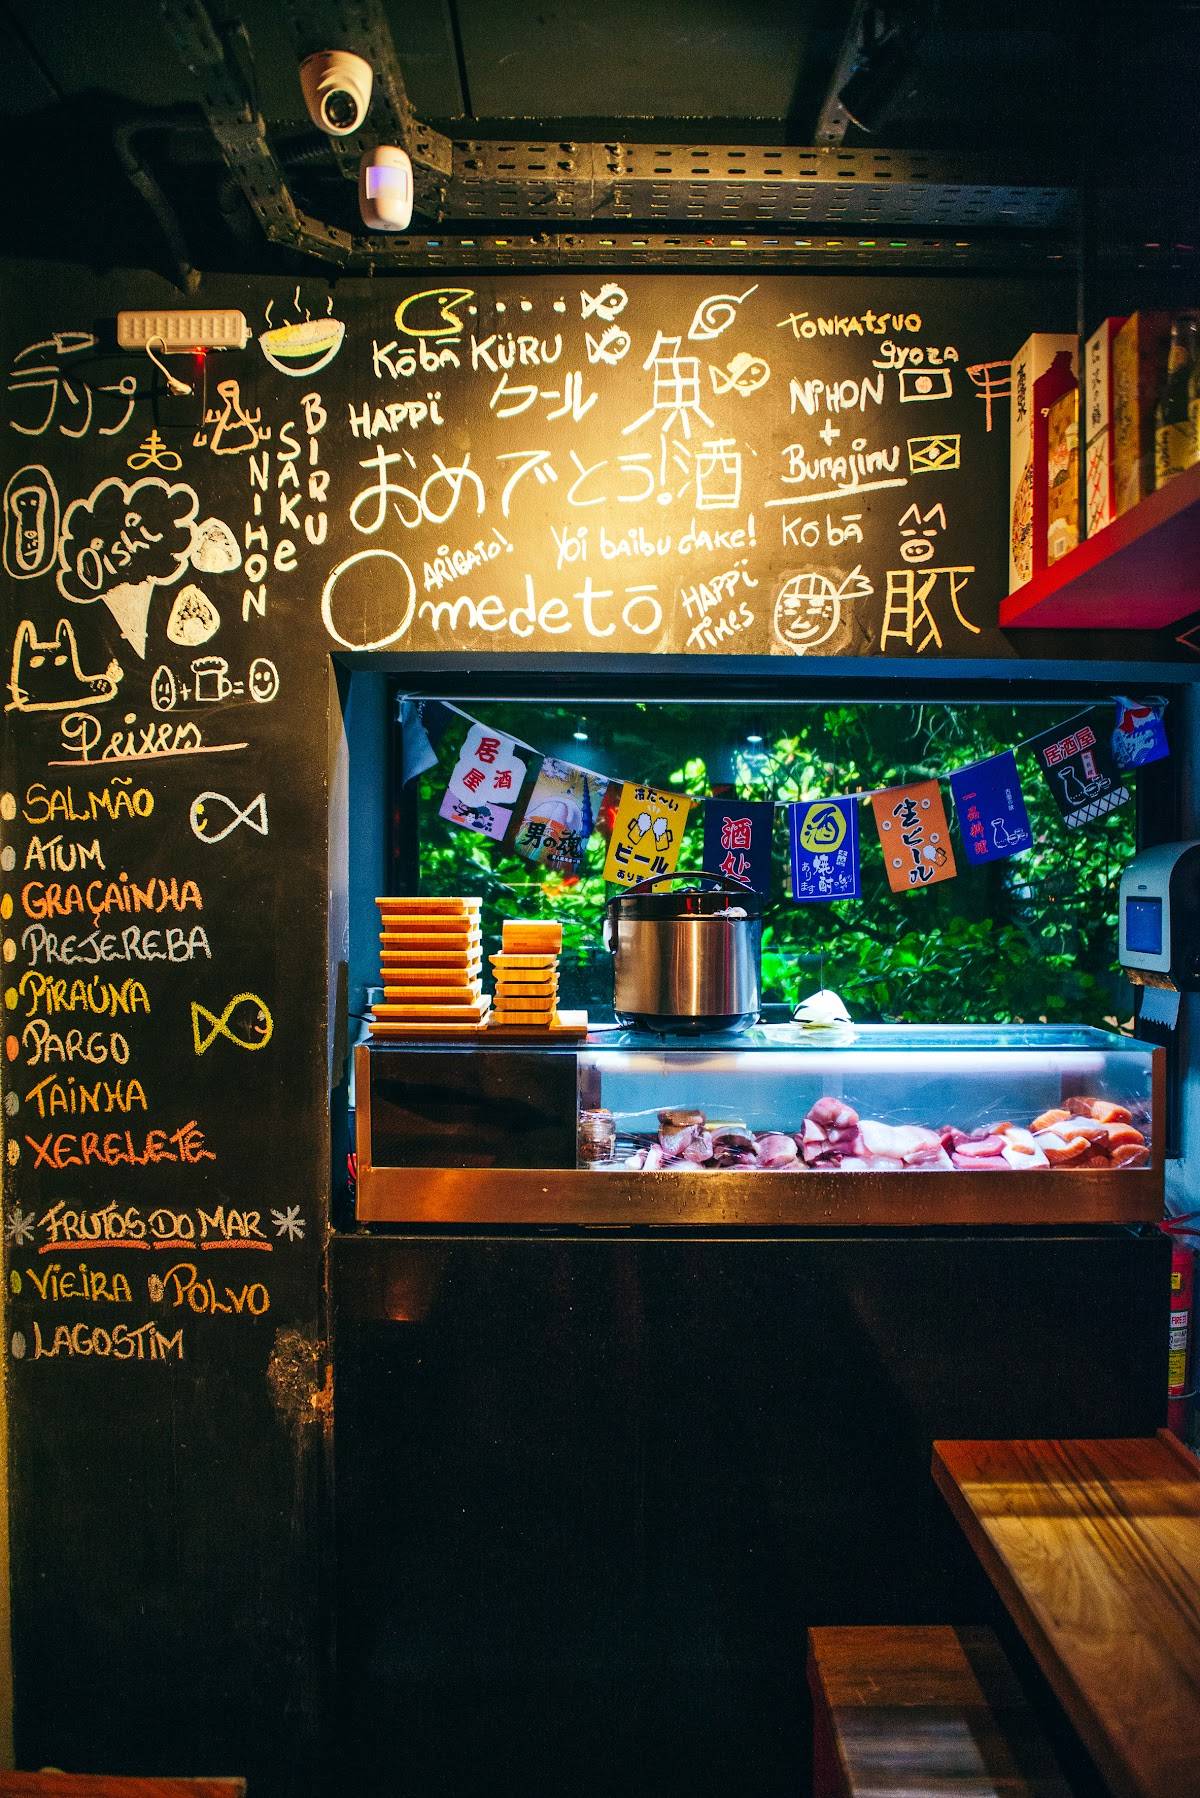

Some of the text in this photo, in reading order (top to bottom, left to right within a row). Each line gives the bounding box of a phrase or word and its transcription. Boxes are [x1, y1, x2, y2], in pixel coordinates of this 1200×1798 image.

[489, 371, 598, 421] クール
[621, 330, 715, 439] 魚
[1042, 725, 1097, 768] 居酒屋
[22, 777, 155, 824] SALMÃO
[24, 835, 106, 872] ATUM
[615, 842, 669, 875] ビール
[21, 922, 212, 966] PREJEREBA
[23, 1019, 129, 1066] PARGO
[25, 1120, 216, 1169] XERELETE
[149, 1209, 195, 1240] DO
[197, 1205, 267, 1240] MAR
[163, 1262, 270, 1315] POLVO
